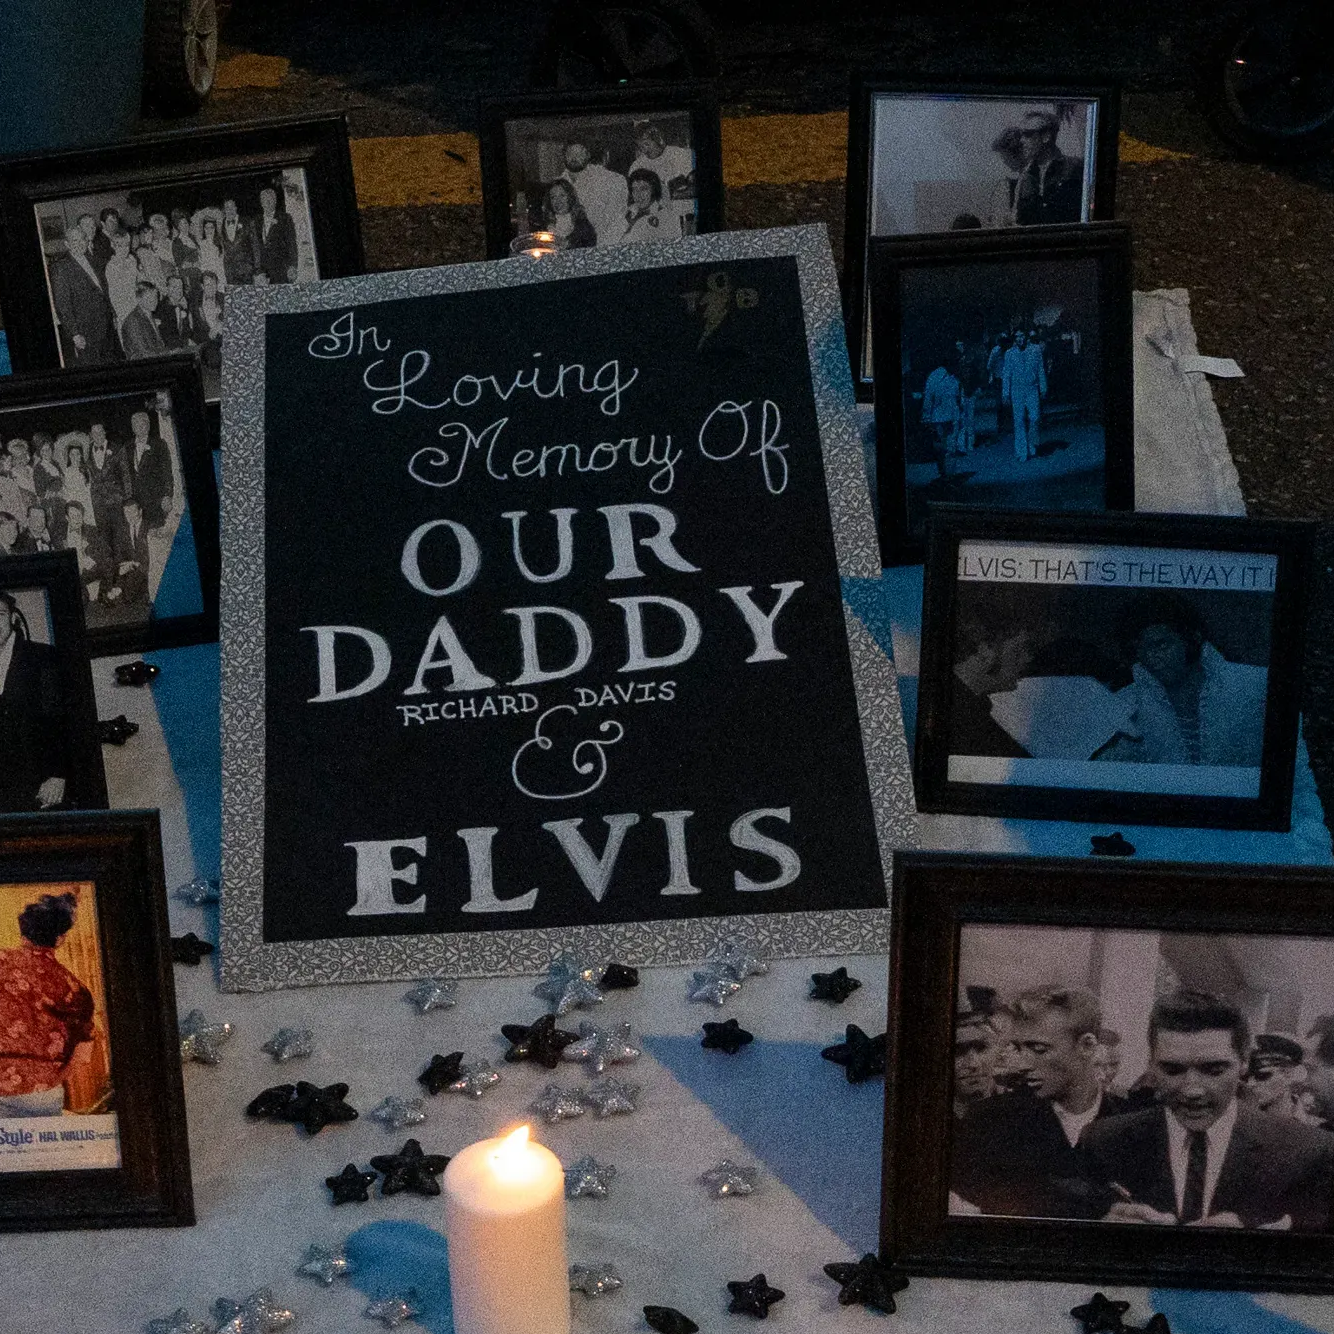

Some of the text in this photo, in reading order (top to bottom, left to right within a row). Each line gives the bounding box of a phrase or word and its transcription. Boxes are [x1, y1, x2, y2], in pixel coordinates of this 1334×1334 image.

[308, 311, 392, 359] In
[363, 349, 640, 416] Loving
[408, 400, 790, 494] Memory Of
[400, 502, 702, 597] OUR
[1028, 558, 1118, 583] THAT'S
[1123, 561, 1173, 585] THE
[1179, 564, 1236, 586] WAY
[1240, 566, 1264, 587] IT
[300, 581, 805, 703] DADDY
[396, 681, 677, 726] RICHARD DAVIS
[511, 704, 624, 799] &
[344, 807, 802, 916] ELVIS
